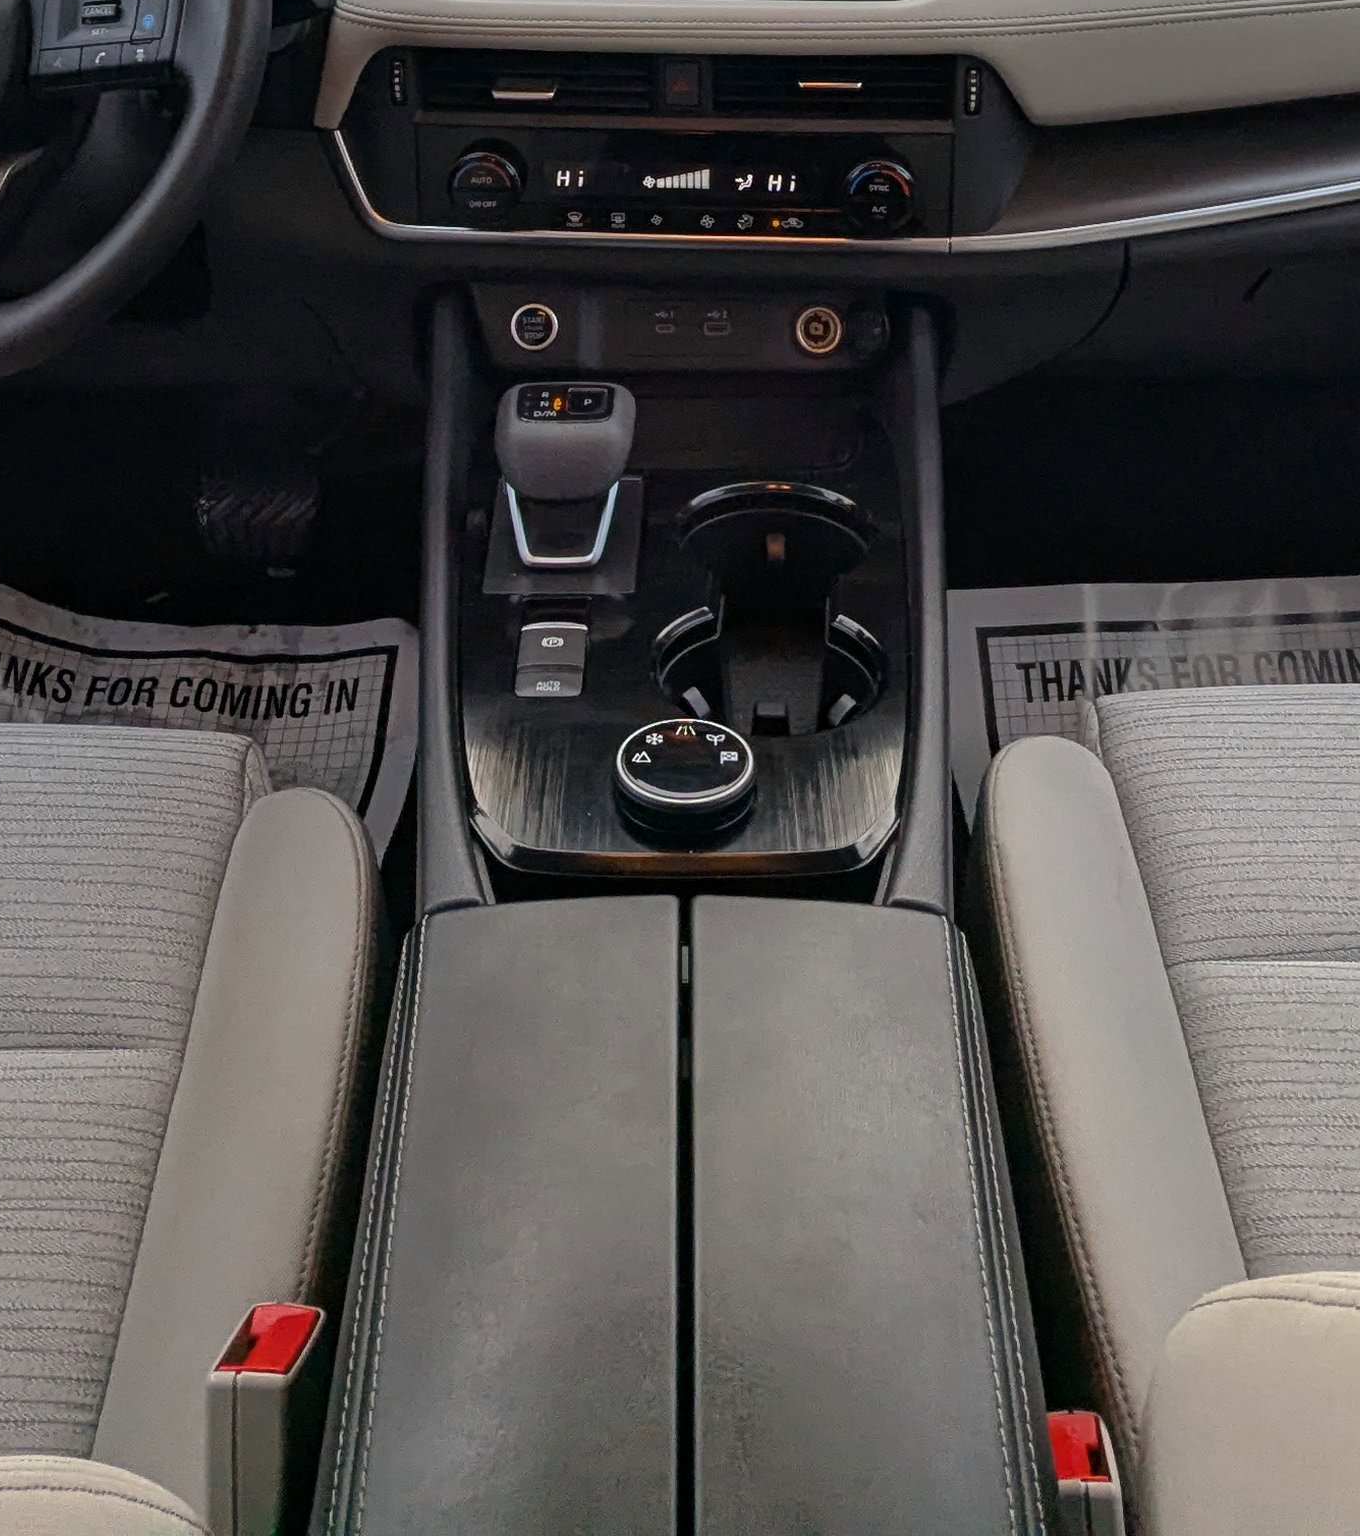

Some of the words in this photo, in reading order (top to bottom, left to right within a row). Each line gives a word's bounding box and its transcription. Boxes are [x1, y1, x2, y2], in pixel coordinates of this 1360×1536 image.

[470, 176, 493, 184] AUTO
[555, 169, 585, 188] Hi
[767, 173, 797, 192] Hi
[868, 184, 890, 193] SYNC
[871, 206, 888, 214] A/C
[583, 398, 592, 406] P
[1016, 657, 1161, 704] THANKS
[1172, 651, 1240, 689] FOR
[84, 675, 156, 708] FOR
[169, 676, 313, 720] COMING
[324, 677, 359, 715] IN
